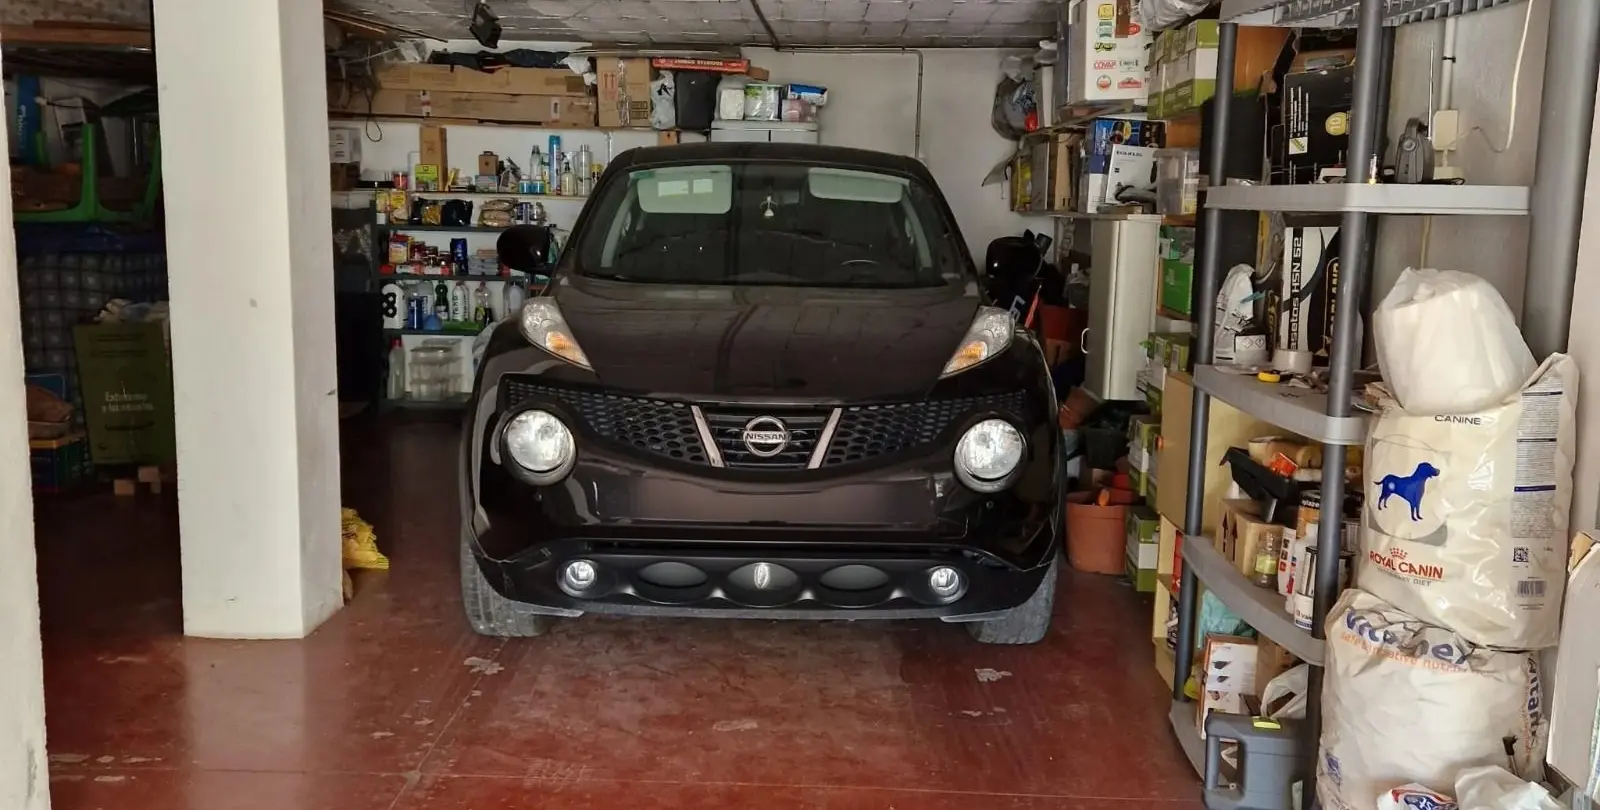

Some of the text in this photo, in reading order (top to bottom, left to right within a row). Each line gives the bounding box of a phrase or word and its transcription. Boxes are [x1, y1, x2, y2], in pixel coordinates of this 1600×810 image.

[1293, 236, 1302, 258] 52
[1291, 262, 1301, 293] HSN
[1434, 414, 1481, 425] CANINE
[745, 432, 786, 440] NISSAN
[1369, 550, 1396, 571] ROYAL
[1398, 561, 1444, 580] CANIN
